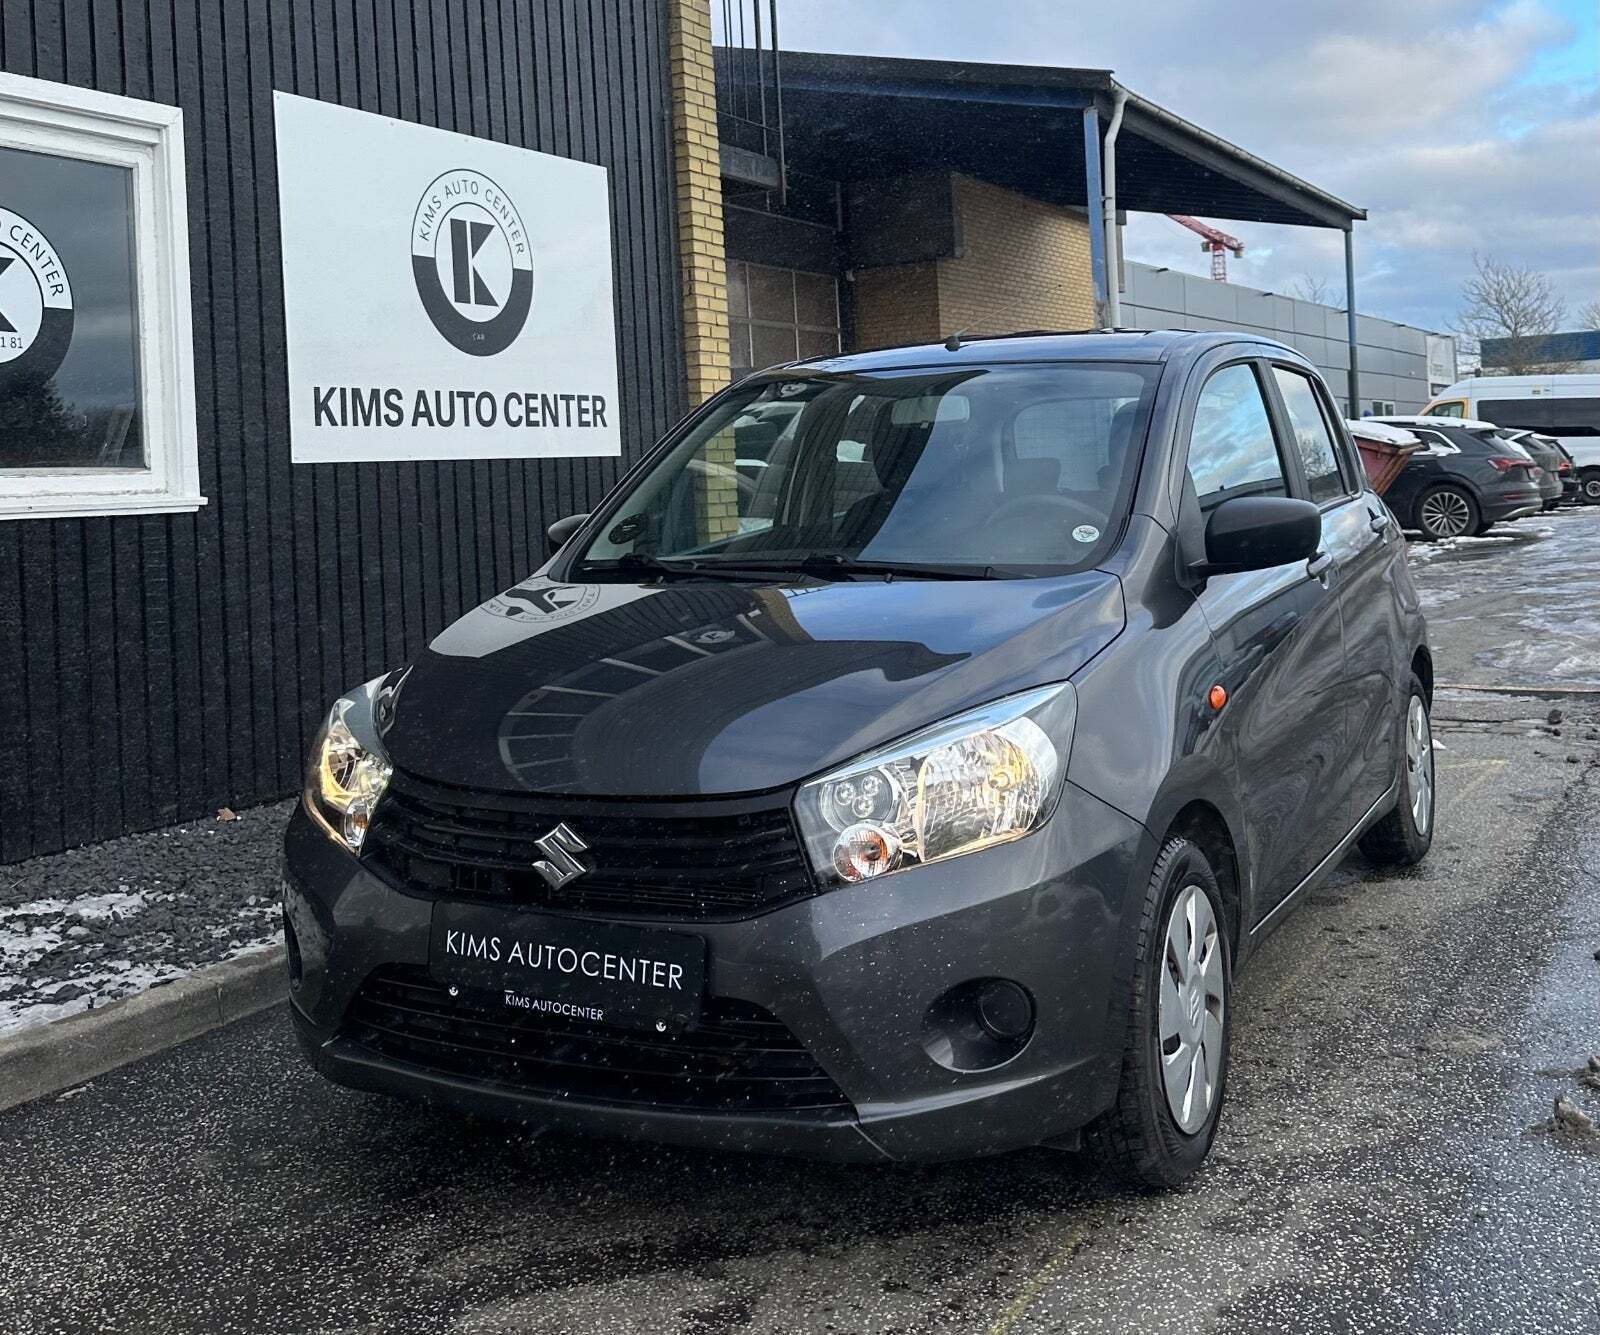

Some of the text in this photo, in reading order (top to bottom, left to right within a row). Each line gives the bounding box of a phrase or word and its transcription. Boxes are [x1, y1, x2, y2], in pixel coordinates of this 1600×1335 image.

[418, 179, 525, 254] KIMS AUTO CENTER
[9, 225, 65, 297] CENTER
[449, 217, 499, 308] K
[10, 337, 23, 349] 81
[313, 386, 608, 428] KIMS AUTO CENTER
[445, 928, 683, 991] KIMS AUTOCENTER
[504, 993, 604, 1022] KIMS AUTOCENTER
